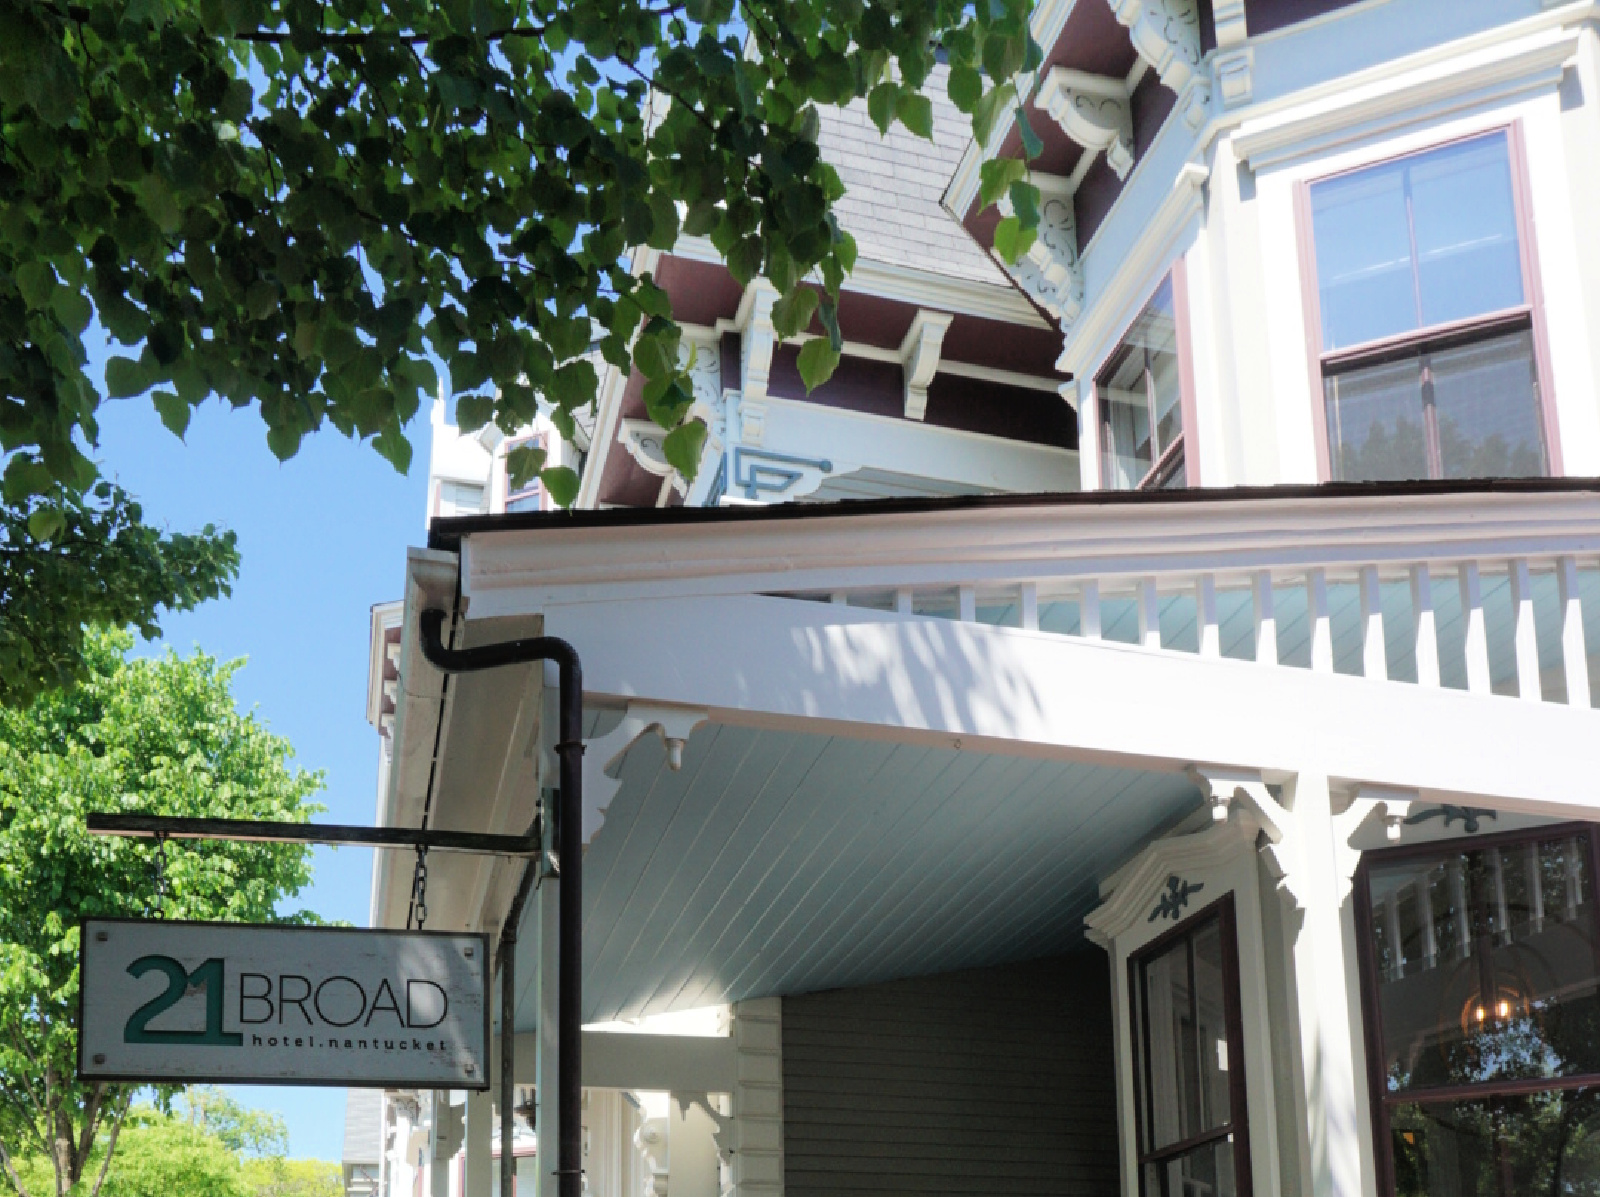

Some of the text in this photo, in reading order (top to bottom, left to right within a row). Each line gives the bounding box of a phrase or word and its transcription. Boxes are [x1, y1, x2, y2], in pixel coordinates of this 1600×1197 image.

[123, 954, 448, 1047] 21 BROAD
[252, 1033, 447, 1051] hotel.nantucket
